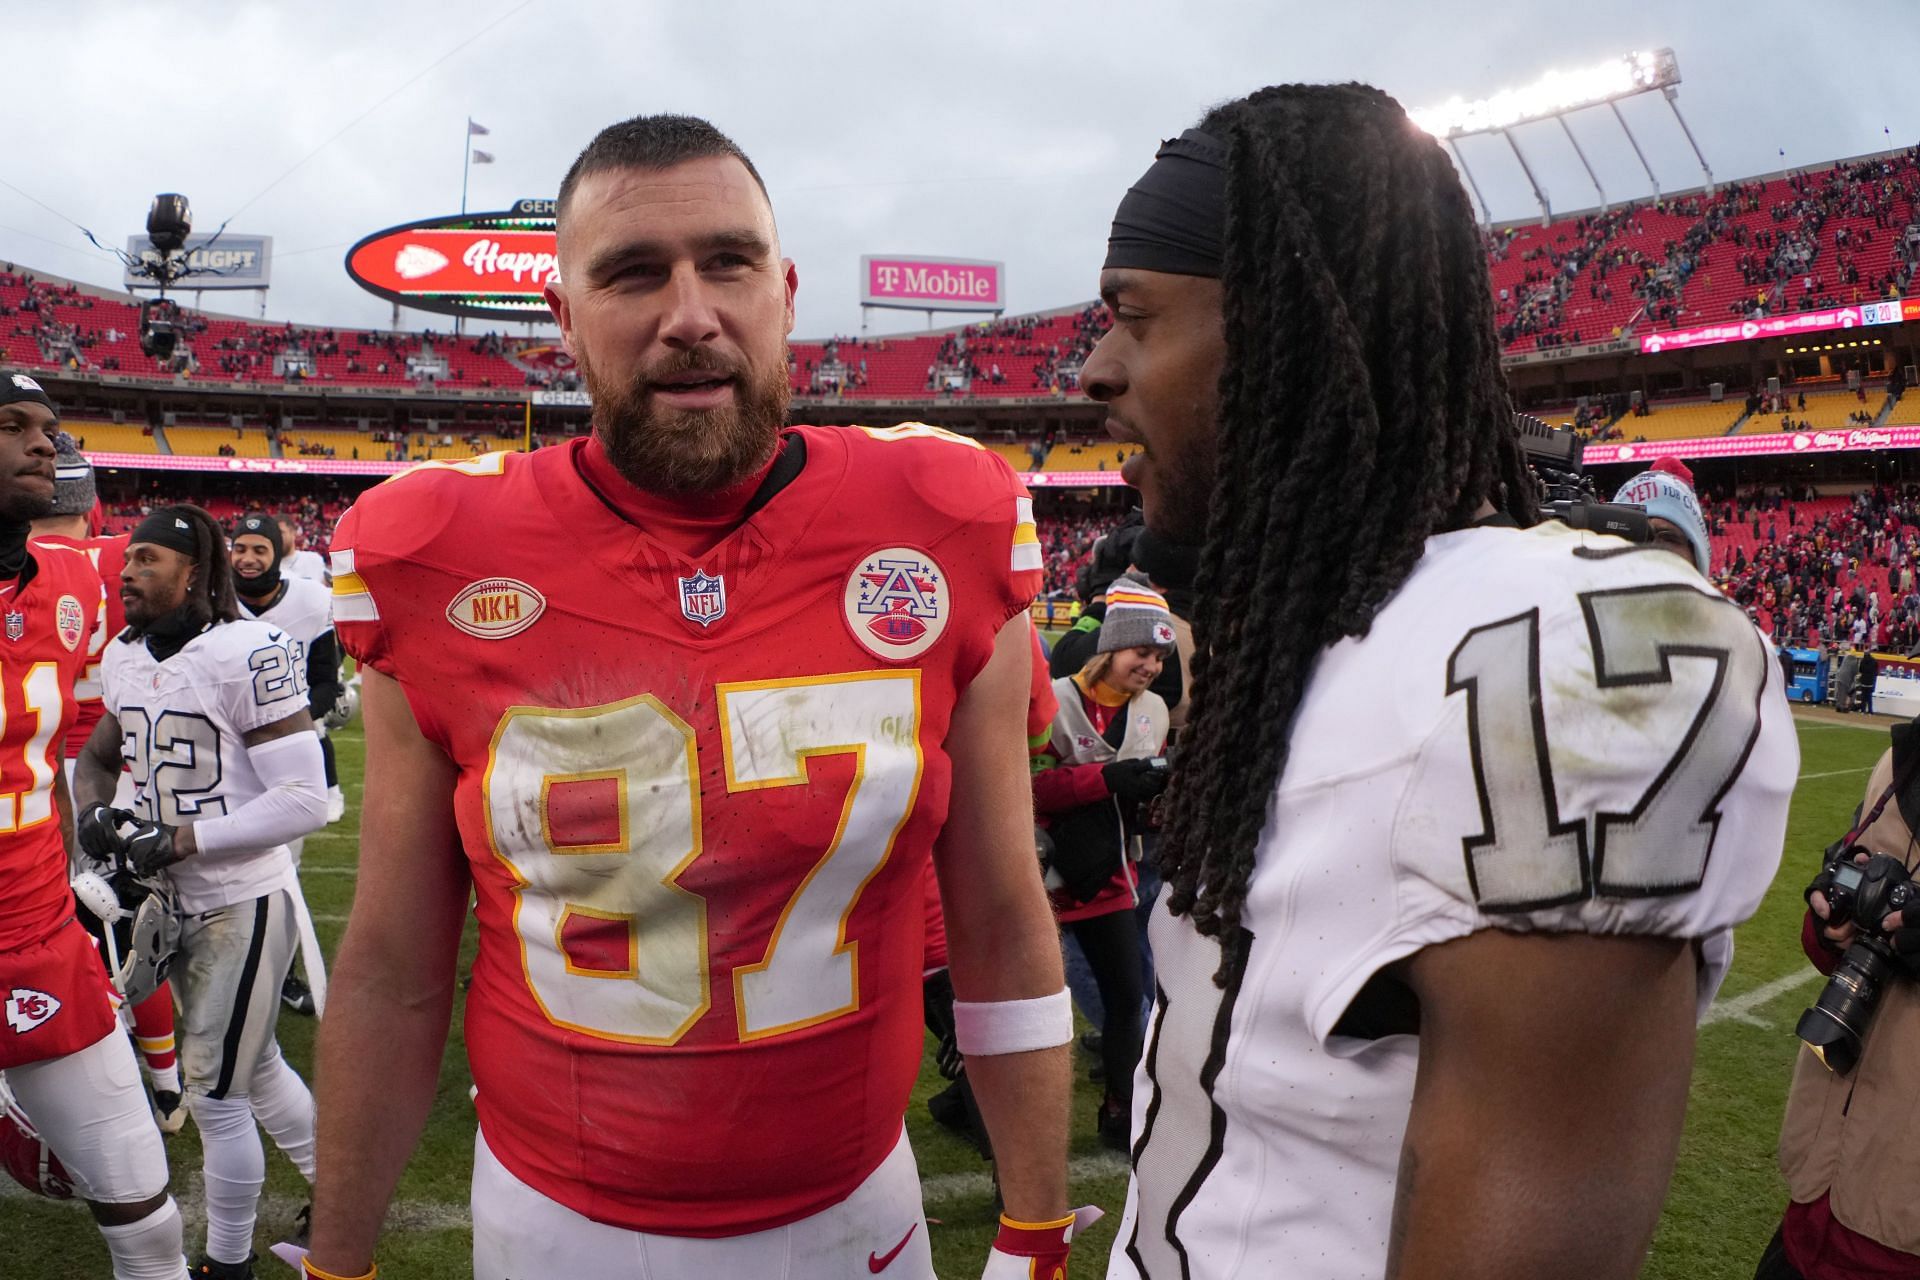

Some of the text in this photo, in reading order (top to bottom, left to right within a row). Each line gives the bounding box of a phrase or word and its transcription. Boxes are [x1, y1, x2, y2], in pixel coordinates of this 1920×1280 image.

[520, 200, 557, 213] GEH
[190, 251, 255, 267] LIGHT
[463, 239, 562, 284] Happy
[903, 268, 990, 297] Mobile
[1626, 481, 1658, 503] YETI
[471, 593, 521, 623] NKH
[687, 593, 720, 616] NFL
[248, 638, 310, 707] 22
[1444, 583, 1768, 914] 17
[119, 706, 228, 827] 22
[482, 668, 924, 1047] 87
[16, 995, 49, 1020] KC
